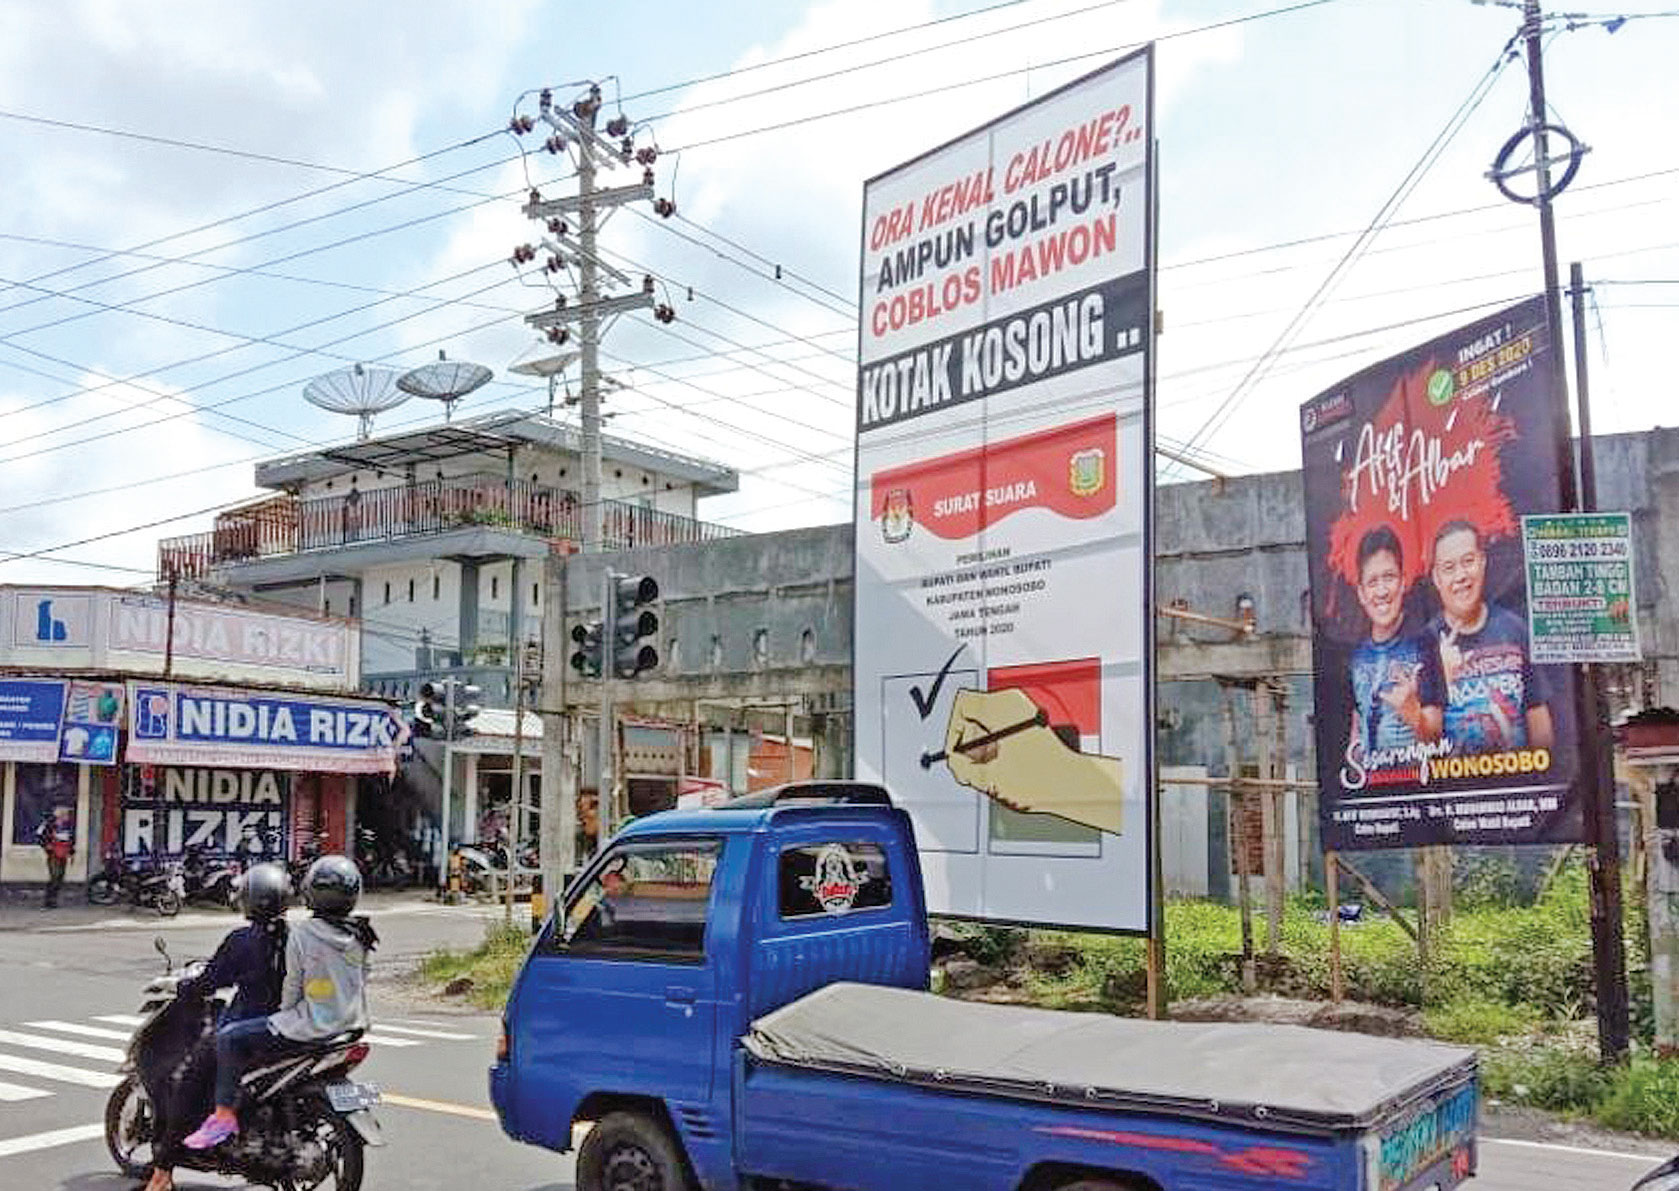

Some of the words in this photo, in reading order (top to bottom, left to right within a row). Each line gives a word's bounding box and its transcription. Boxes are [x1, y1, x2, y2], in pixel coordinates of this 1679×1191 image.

[870, 203, 913, 251] ORA
[918, 167, 995, 232] KENAL
[877, 222, 974, 292] AMPUN
[985, 162, 1121, 248] GOLPUT,
[872, 267, 980, 337] COBLOS
[991, 214, 1116, 294] MAWON
[862, 344, 952, 424] KOTAK
[962, 293, 1104, 394] KOSONG
[1459, 329, 1502, 362] INGAT
[1472, 358, 1495, 379] DES
[1498, 338, 1529, 365] 2020
[934, 491, 980, 517] SURAT
[985, 480, 1037, 505] SUARA
[119, 607, 229, 651] NIDIA
[244, 621, 339, 664] RIZKI
[990, 622, 1014, 635] 2020
[181, 699, 297, 741] NIDIA
[1431, 749, 1550, 779] WONOSOBO
[165, 768, 281, 804] NIDIA
